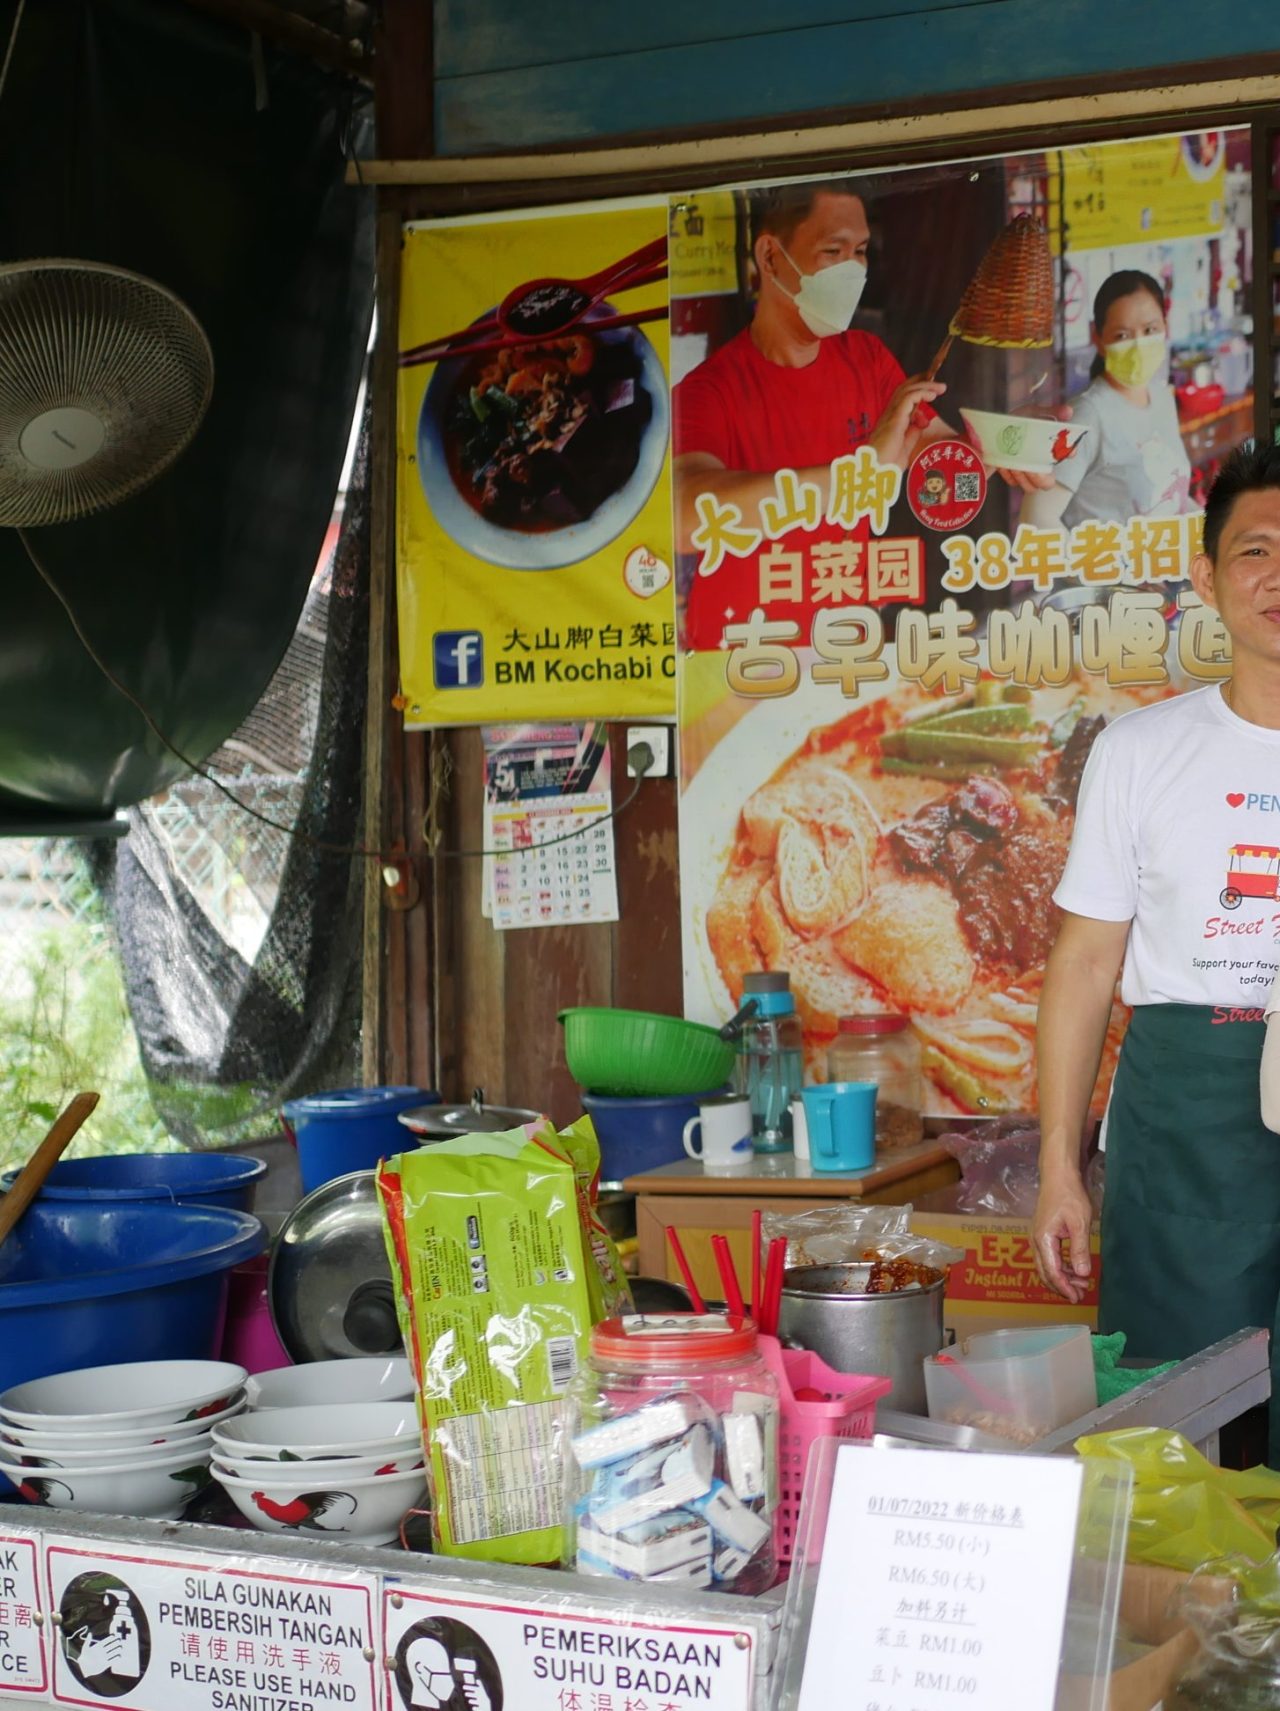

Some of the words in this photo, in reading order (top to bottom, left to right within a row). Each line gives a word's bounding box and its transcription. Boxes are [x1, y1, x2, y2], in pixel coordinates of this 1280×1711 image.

[692, 446, 901, 576] 大山脚
[757, 537, 922, 603] 白菜园
[495, 661, 535, 684] BM
[545, 656, 652, 683] Kochabi
[1203, 917, 1265, 939] Street
[1192, 957, 1228, 972] Support
[1229, 958, 1254, 971] your
[965, 1268, 1023, 1287] Instant
[868, 1496, 948, 1518] 01/07/2022
[184, 1577, 225, 1603] SILA
[232, 1585, 331, 1617] GUNAKAN
[159, 1602, 274, 1637] PEMBERSIH
[279, 1619, 363, 1649] TANGAN
[919, 1634, 983, 1657] RM1.00
[180, 1631, 343, 1677] 请使用洗手液
[523, 1624, 722, 1668] PEMERIKSAAN
[171, 1662, 247, 1688] PLEASE
[253, 1671, 293, 1692] USE
[300, 1677, 356, 1703] HAND
[533, 1655, 604, 1687] SUHU
[616, 1667, 711, 1700] BADAN
[913, 1671, 978, 1695] RM1.00
